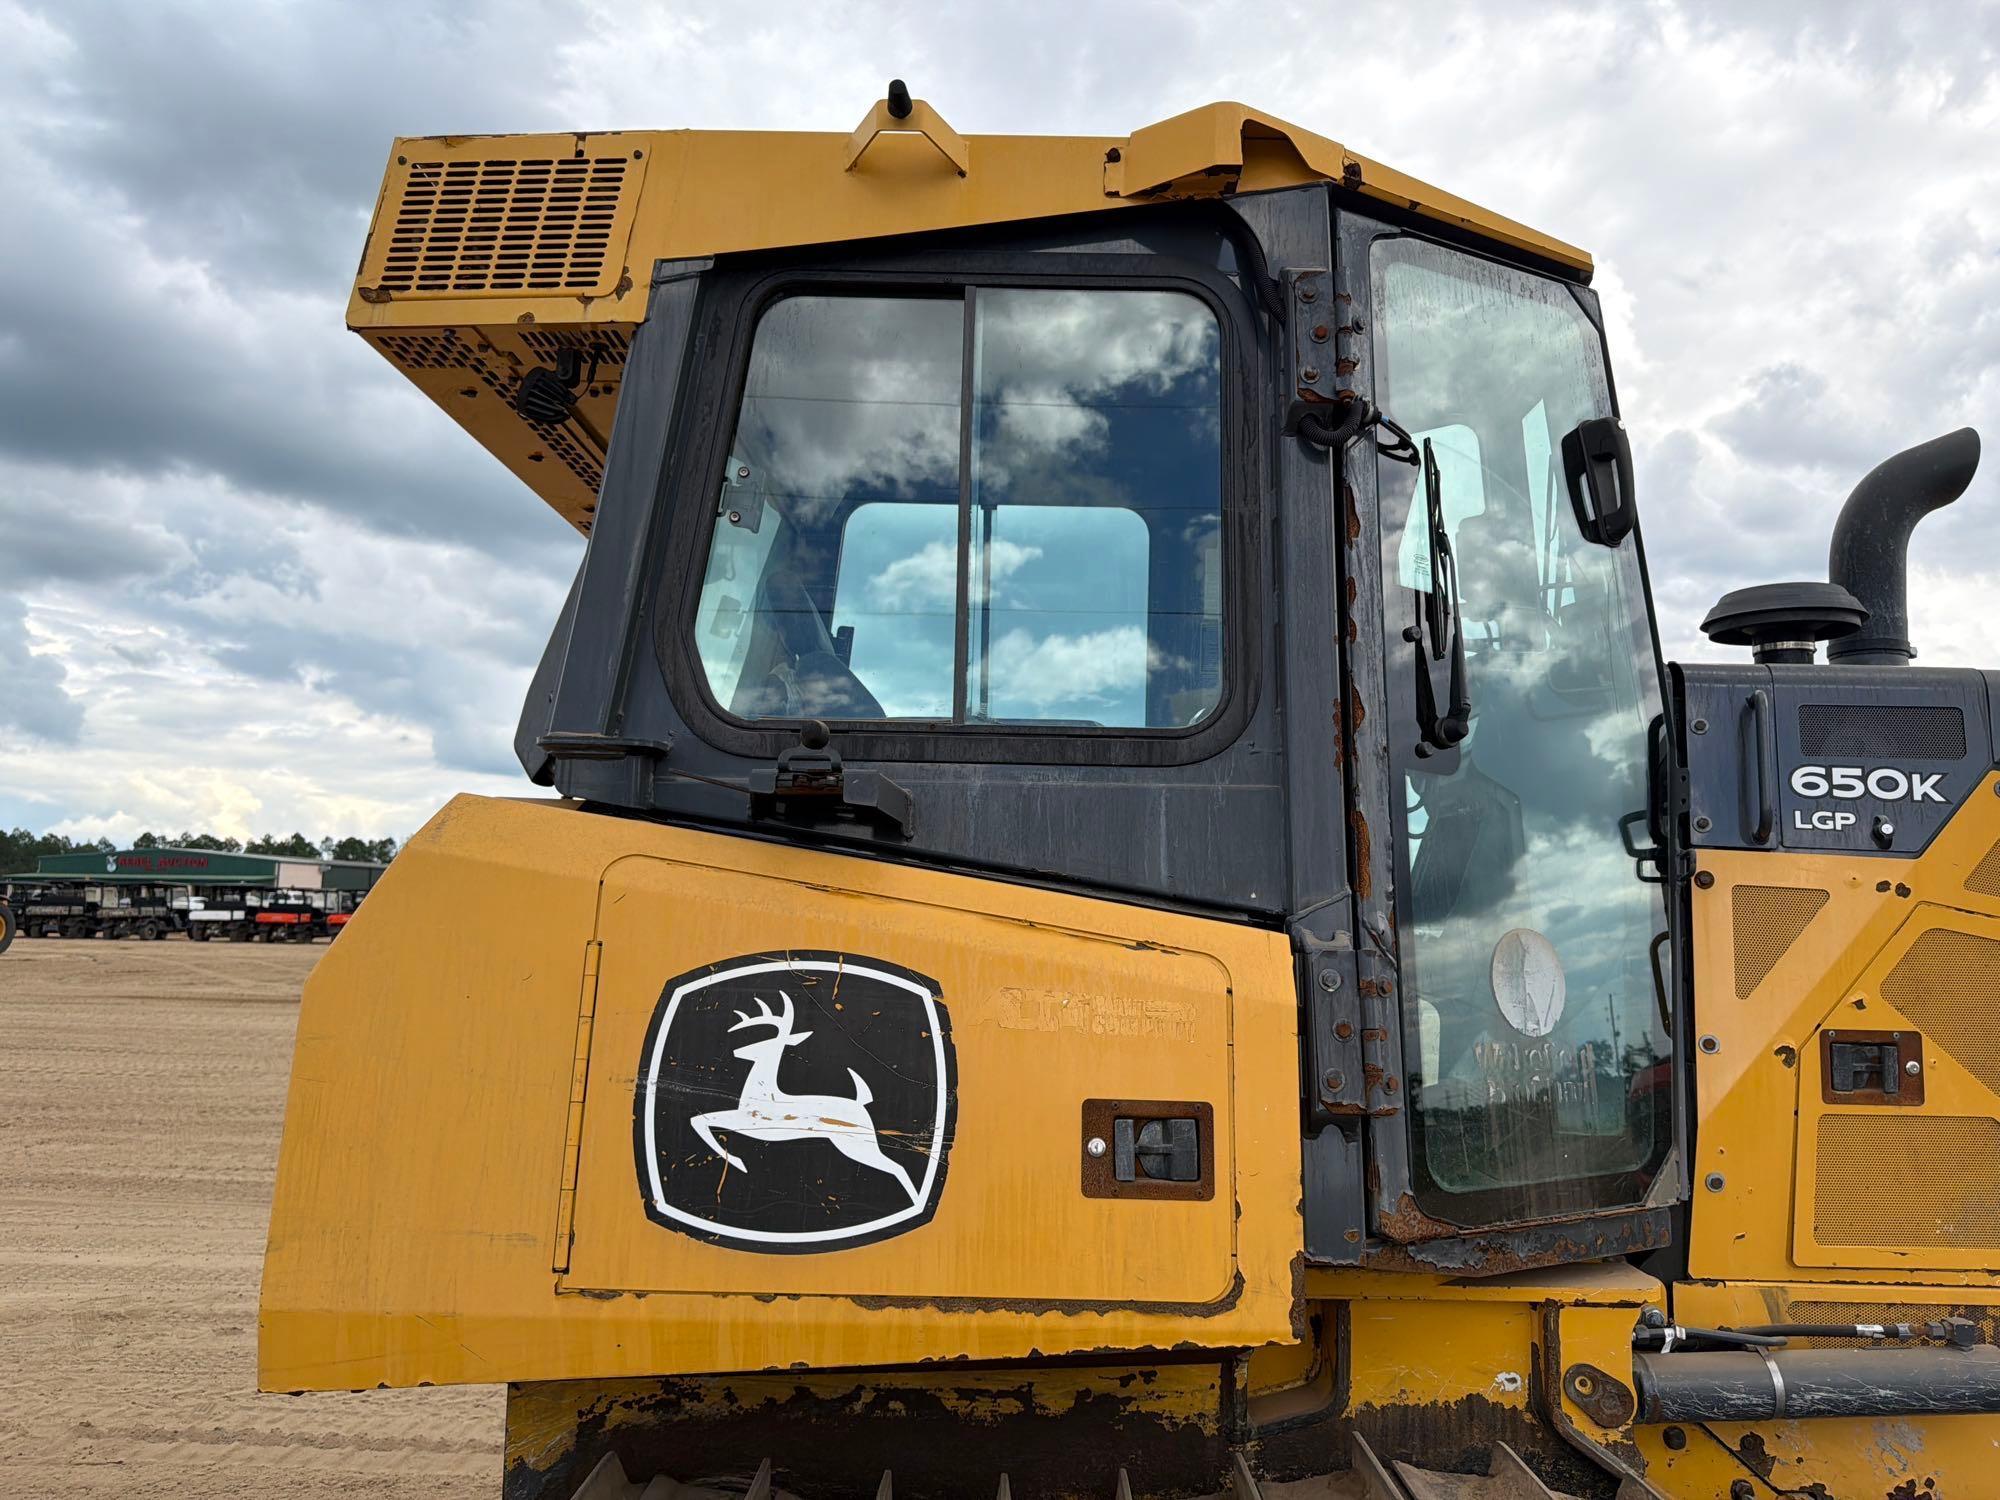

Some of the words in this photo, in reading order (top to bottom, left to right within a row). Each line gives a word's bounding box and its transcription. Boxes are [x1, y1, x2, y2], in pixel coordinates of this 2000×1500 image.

[1791, 766, 1947, 802] 650K
[1794, 810, 1856, 831] LGP
[157, 856, 209, 871] AUCTION
